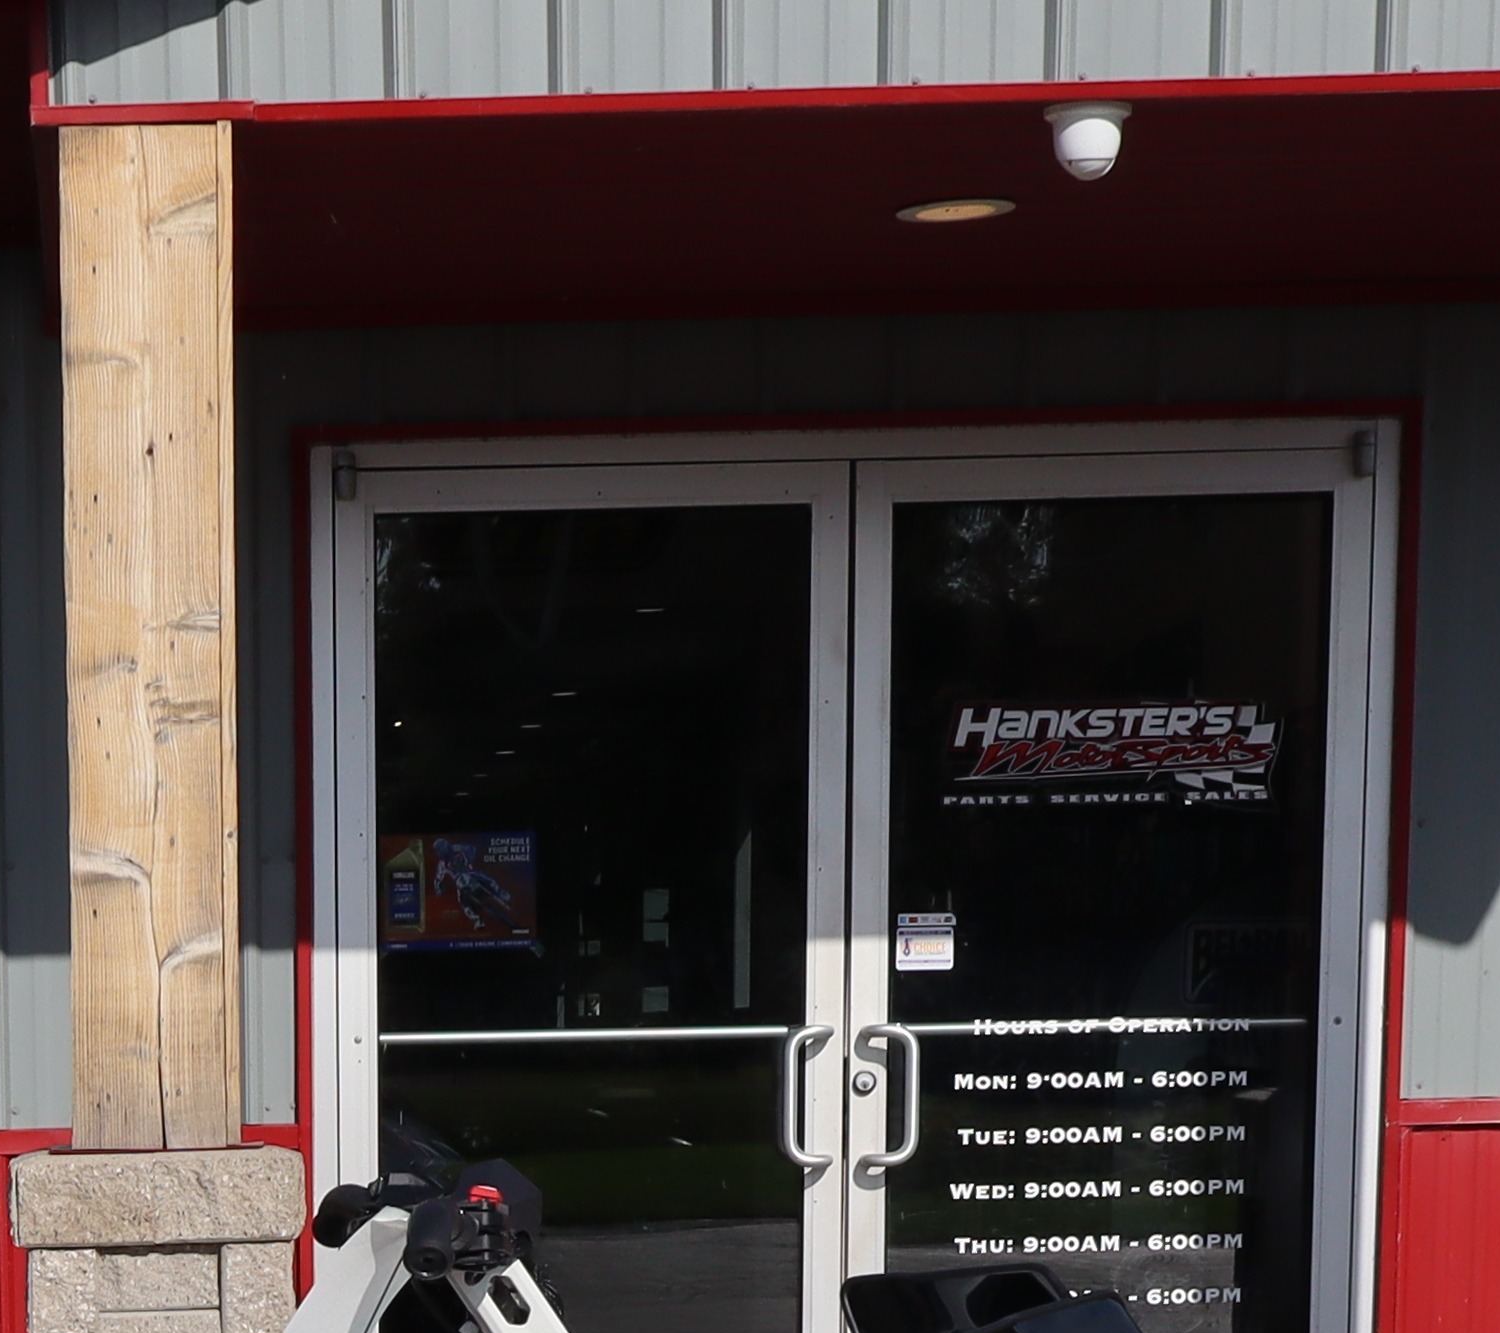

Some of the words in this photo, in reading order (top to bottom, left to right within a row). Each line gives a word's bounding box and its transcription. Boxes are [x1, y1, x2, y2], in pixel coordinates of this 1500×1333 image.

[943, 795, 1030, 805] PARTS
[1050, 793, 1166, 803] SERVICE
[1187, 790, 1268, 801] SALES
[488, 846, 509, 854] YOUR
[510, 845, 530, 854] NEXT
[490, 837, 530, 846] SCHEDULE
[499, 854, 530, 862] CHANGE
[1151, 1070, 1248, 1088] 6:00PM
[1025, 1126, 1123, 1144] 9:00AM
[1150, 1125, 1246, 1142] 6:00PM
[1024, 1180, 1122, 1199] 9:00AM
[1148, 1179, 1245, 1197] 6:00PM
[1022, 1235, 1120, 1253] 9:00AM
[1147, 1233, 1243, 1251] 6:00PM
[1146, 1288, 1242, 1304] 6:00PM
